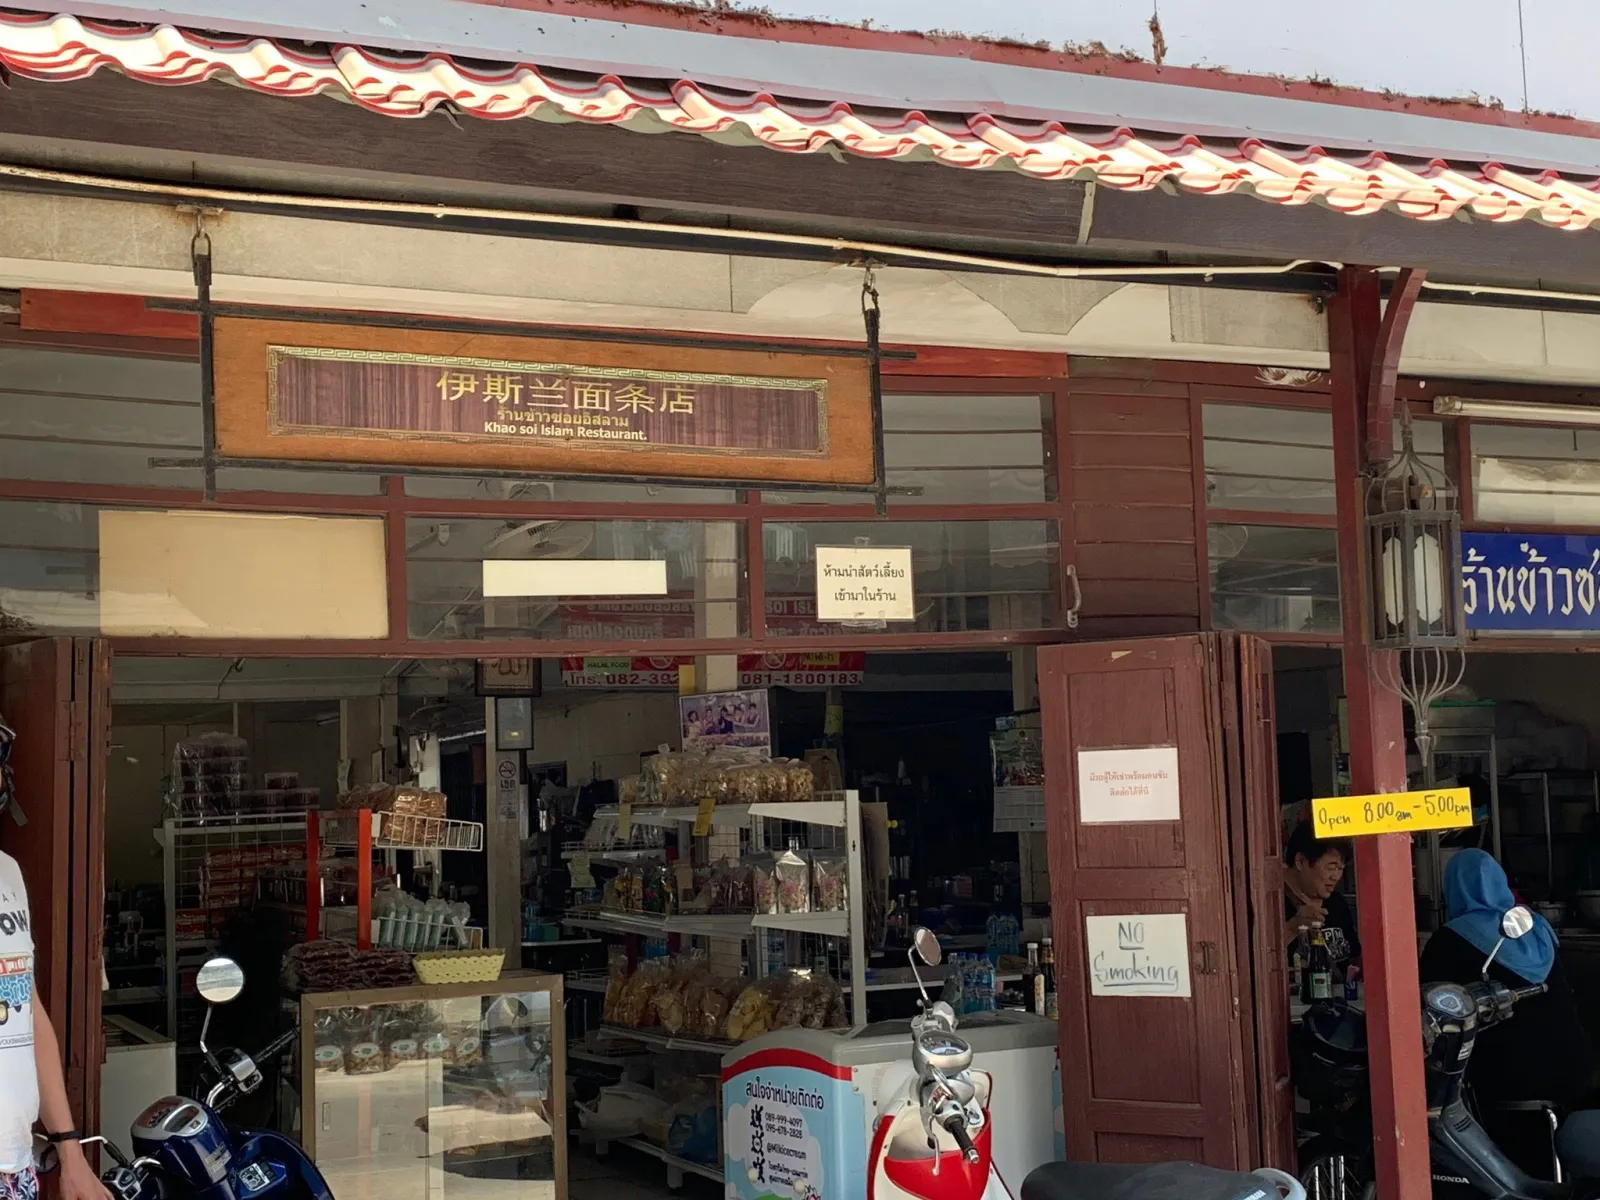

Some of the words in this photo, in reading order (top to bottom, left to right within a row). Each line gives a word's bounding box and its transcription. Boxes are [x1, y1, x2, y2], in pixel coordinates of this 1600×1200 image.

[436, 370, 697, 414] 伊斯兰面条店
[484, 422, 516, 434] Khao
[519, 425, 537, 435] soi
[541, 426, 573, 437] Islam
[823, 561, 905, 578] ห้ามนำสัตว์เลี้ยง
[1461, 541, 1600, 616] ร้านข้าวซ
[834, 585, 897, 602] เข้ามาในร้าน
[1318, 807, 1351, 830] Open
[1118, 921, 1145, 944] NO
[1093, 950, 1179, 992] Smoking
[1432, 1173, 1471, 1185] HONDA
